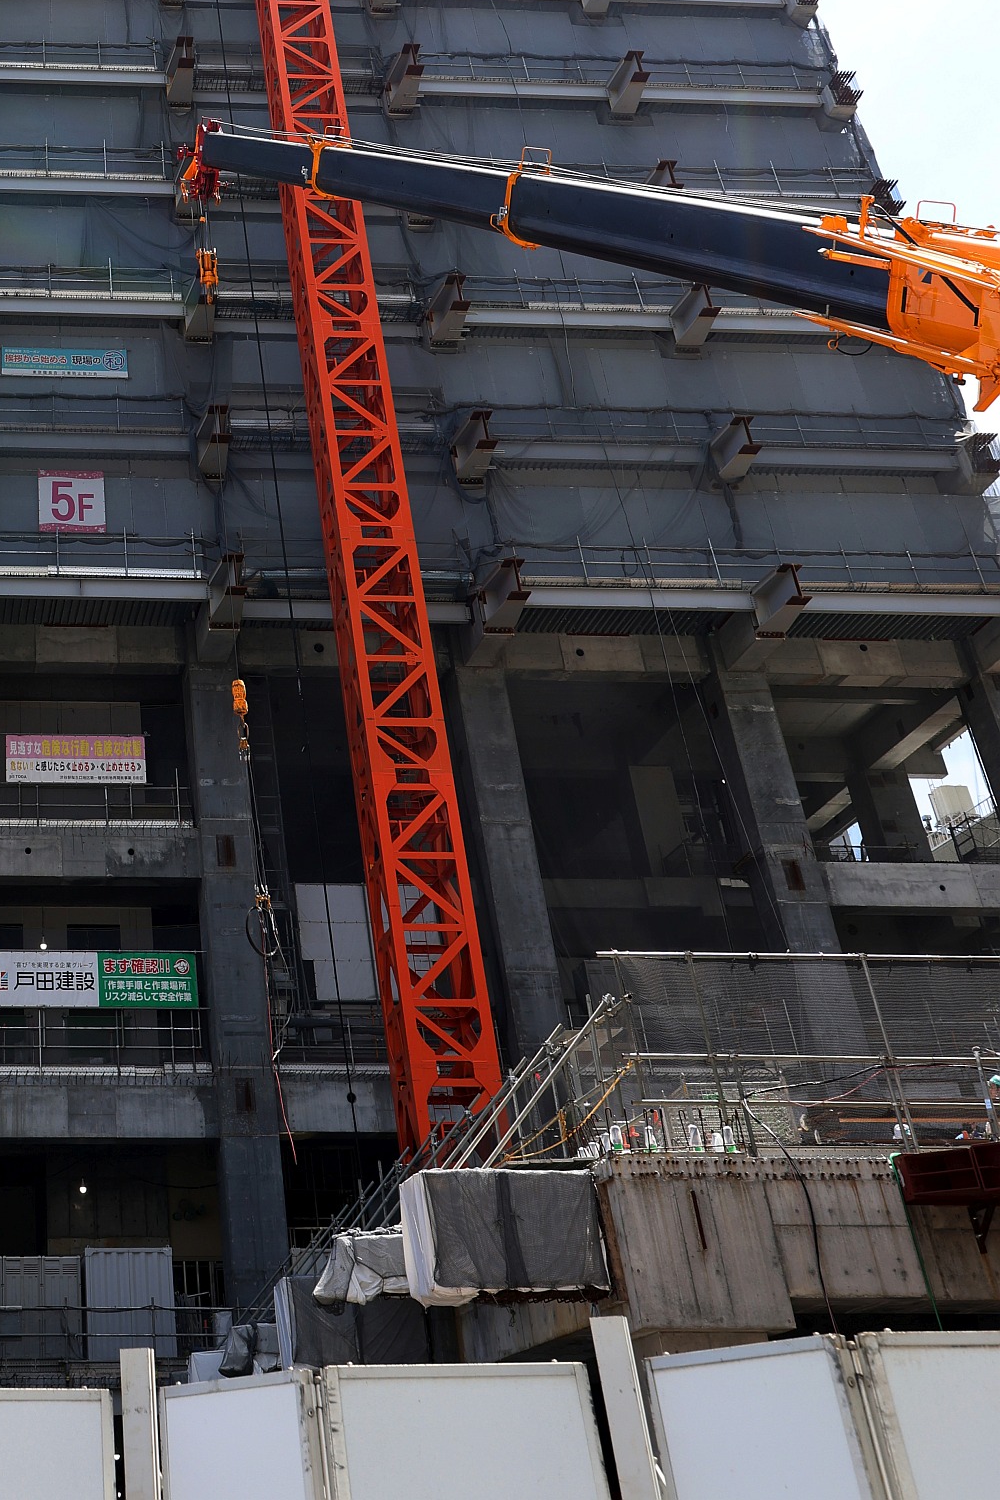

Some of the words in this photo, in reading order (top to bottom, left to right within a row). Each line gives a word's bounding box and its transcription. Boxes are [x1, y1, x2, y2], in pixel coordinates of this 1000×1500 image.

[4, 353, 67, 364] 挨拶から始める
[51, 481, 95, 522] 5F
[103, 958, 171, 975] まず確認!!
[13, 970, 95, 991] 戸田建設
[105, 991, 192, 1002] リスク減らして安全作業
